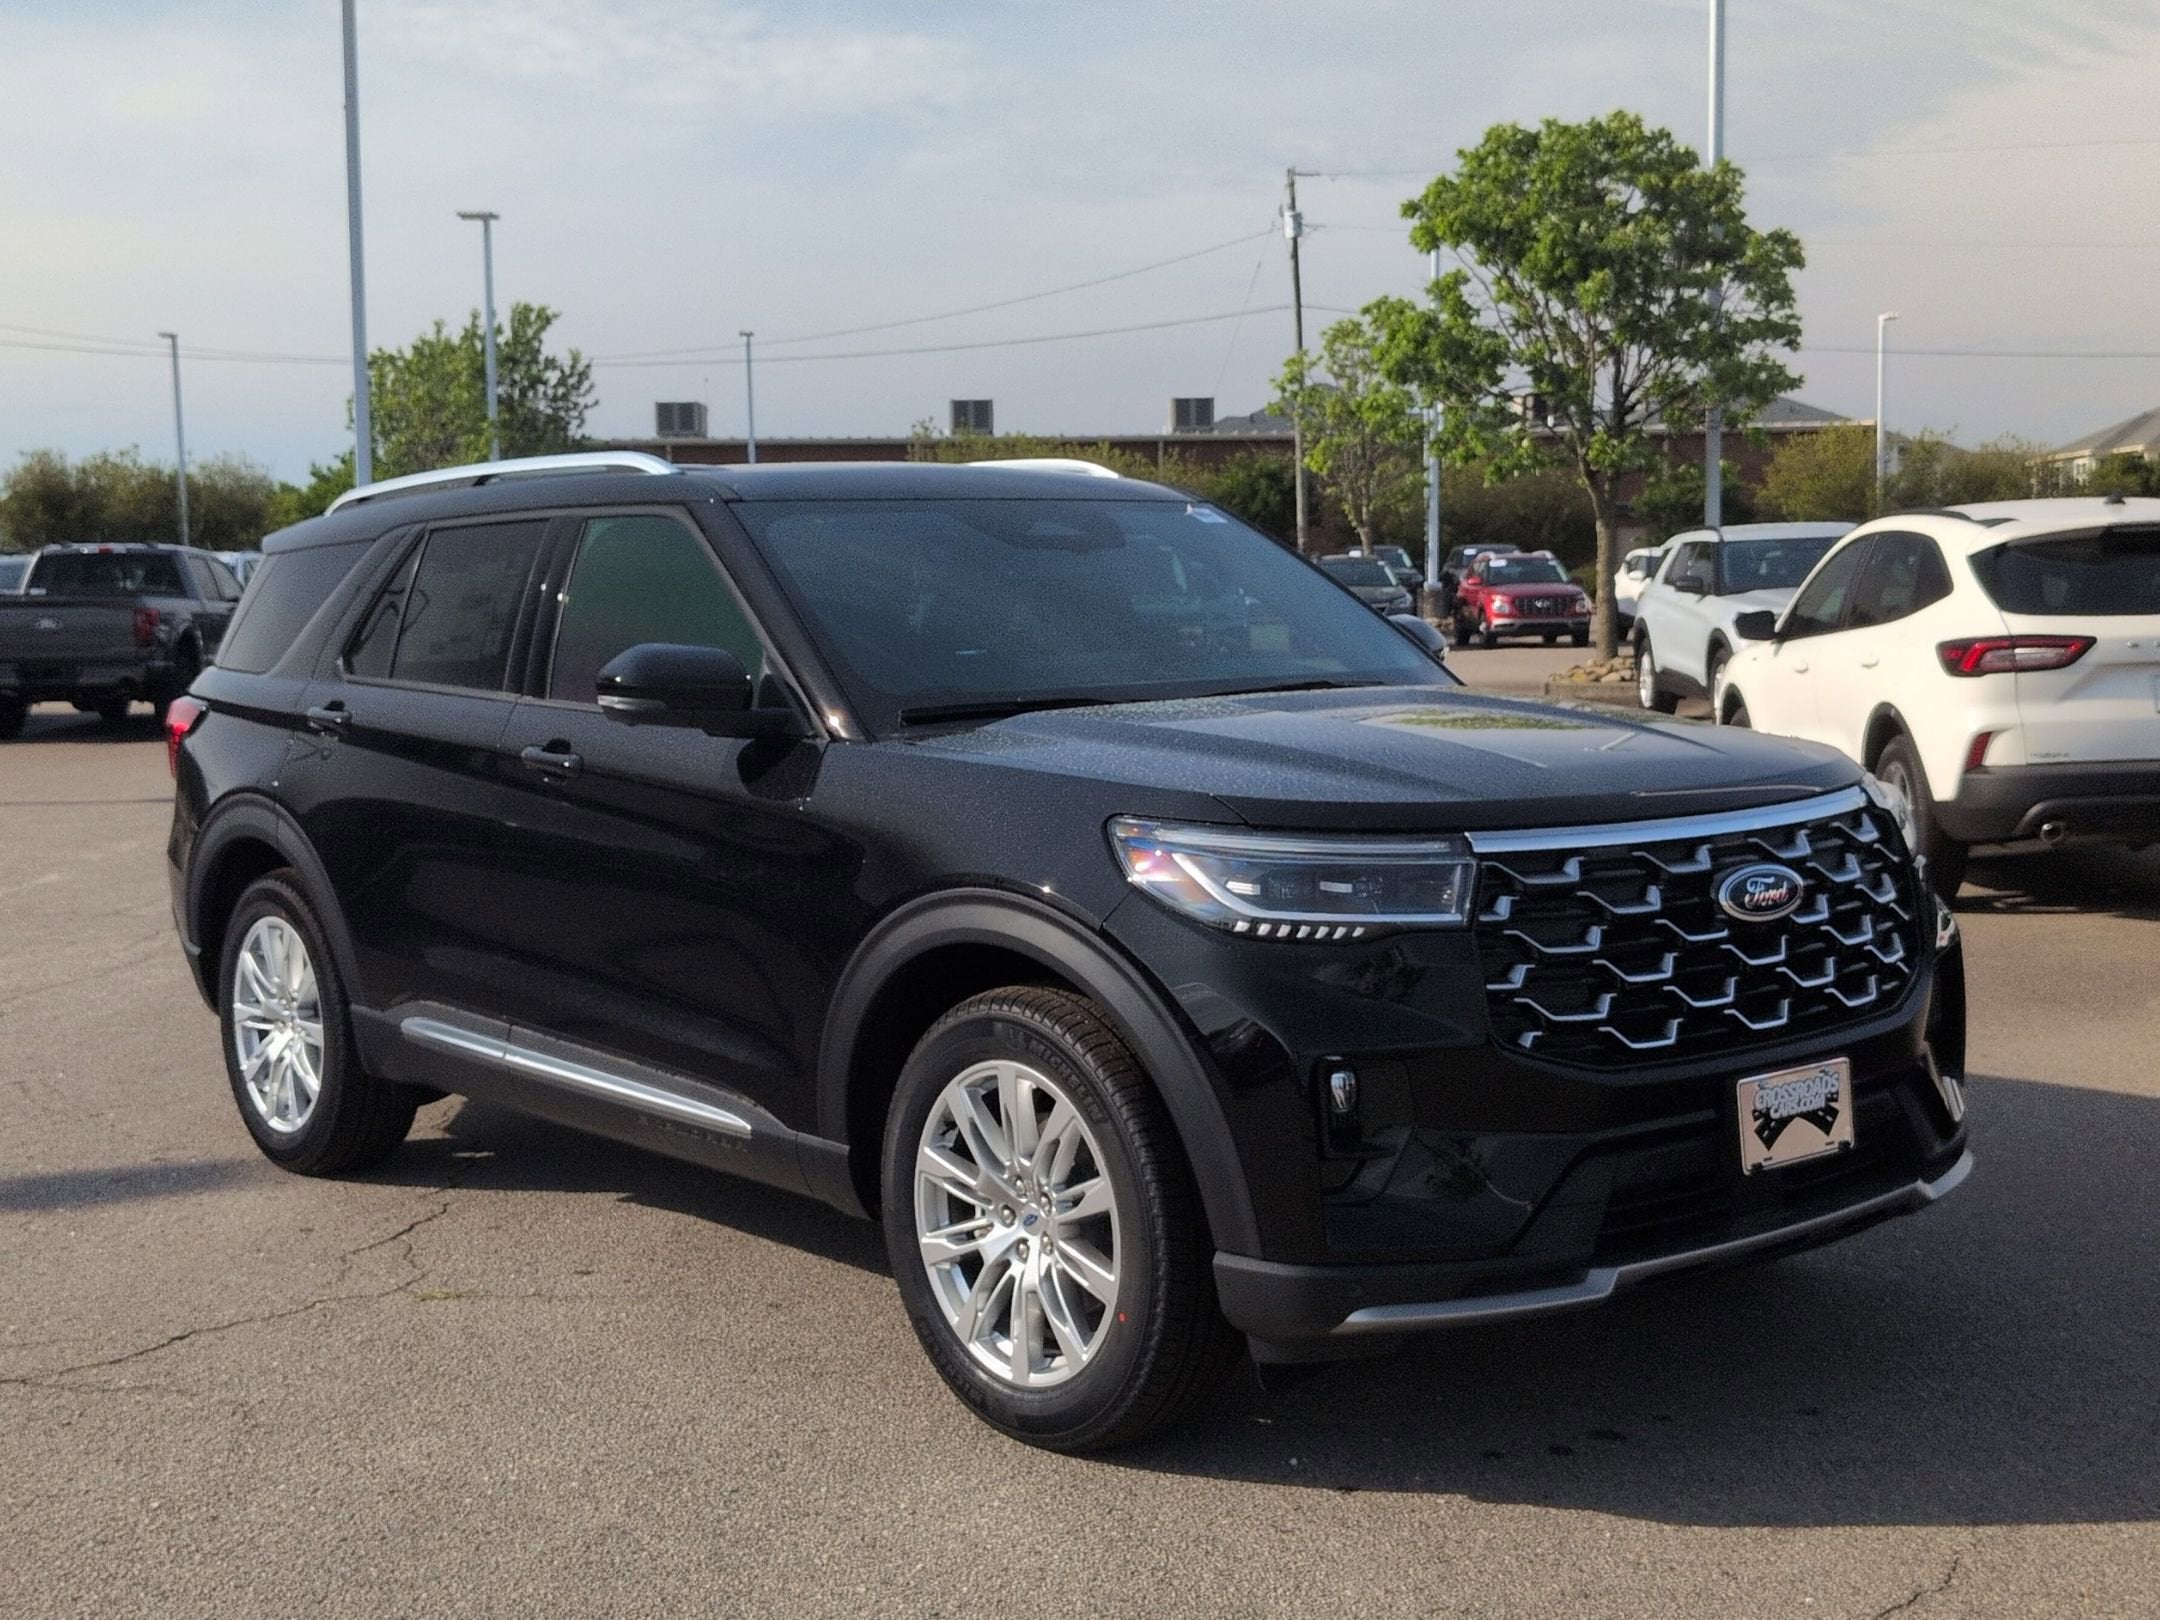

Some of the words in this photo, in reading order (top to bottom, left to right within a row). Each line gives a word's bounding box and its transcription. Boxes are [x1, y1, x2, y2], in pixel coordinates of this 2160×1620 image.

[1744, 876, 1788, 909] Ford
[1027, 1038, 1103, 1122] MICHELIN
[1753, 1072, 1840, 1112] CROSSROADS
